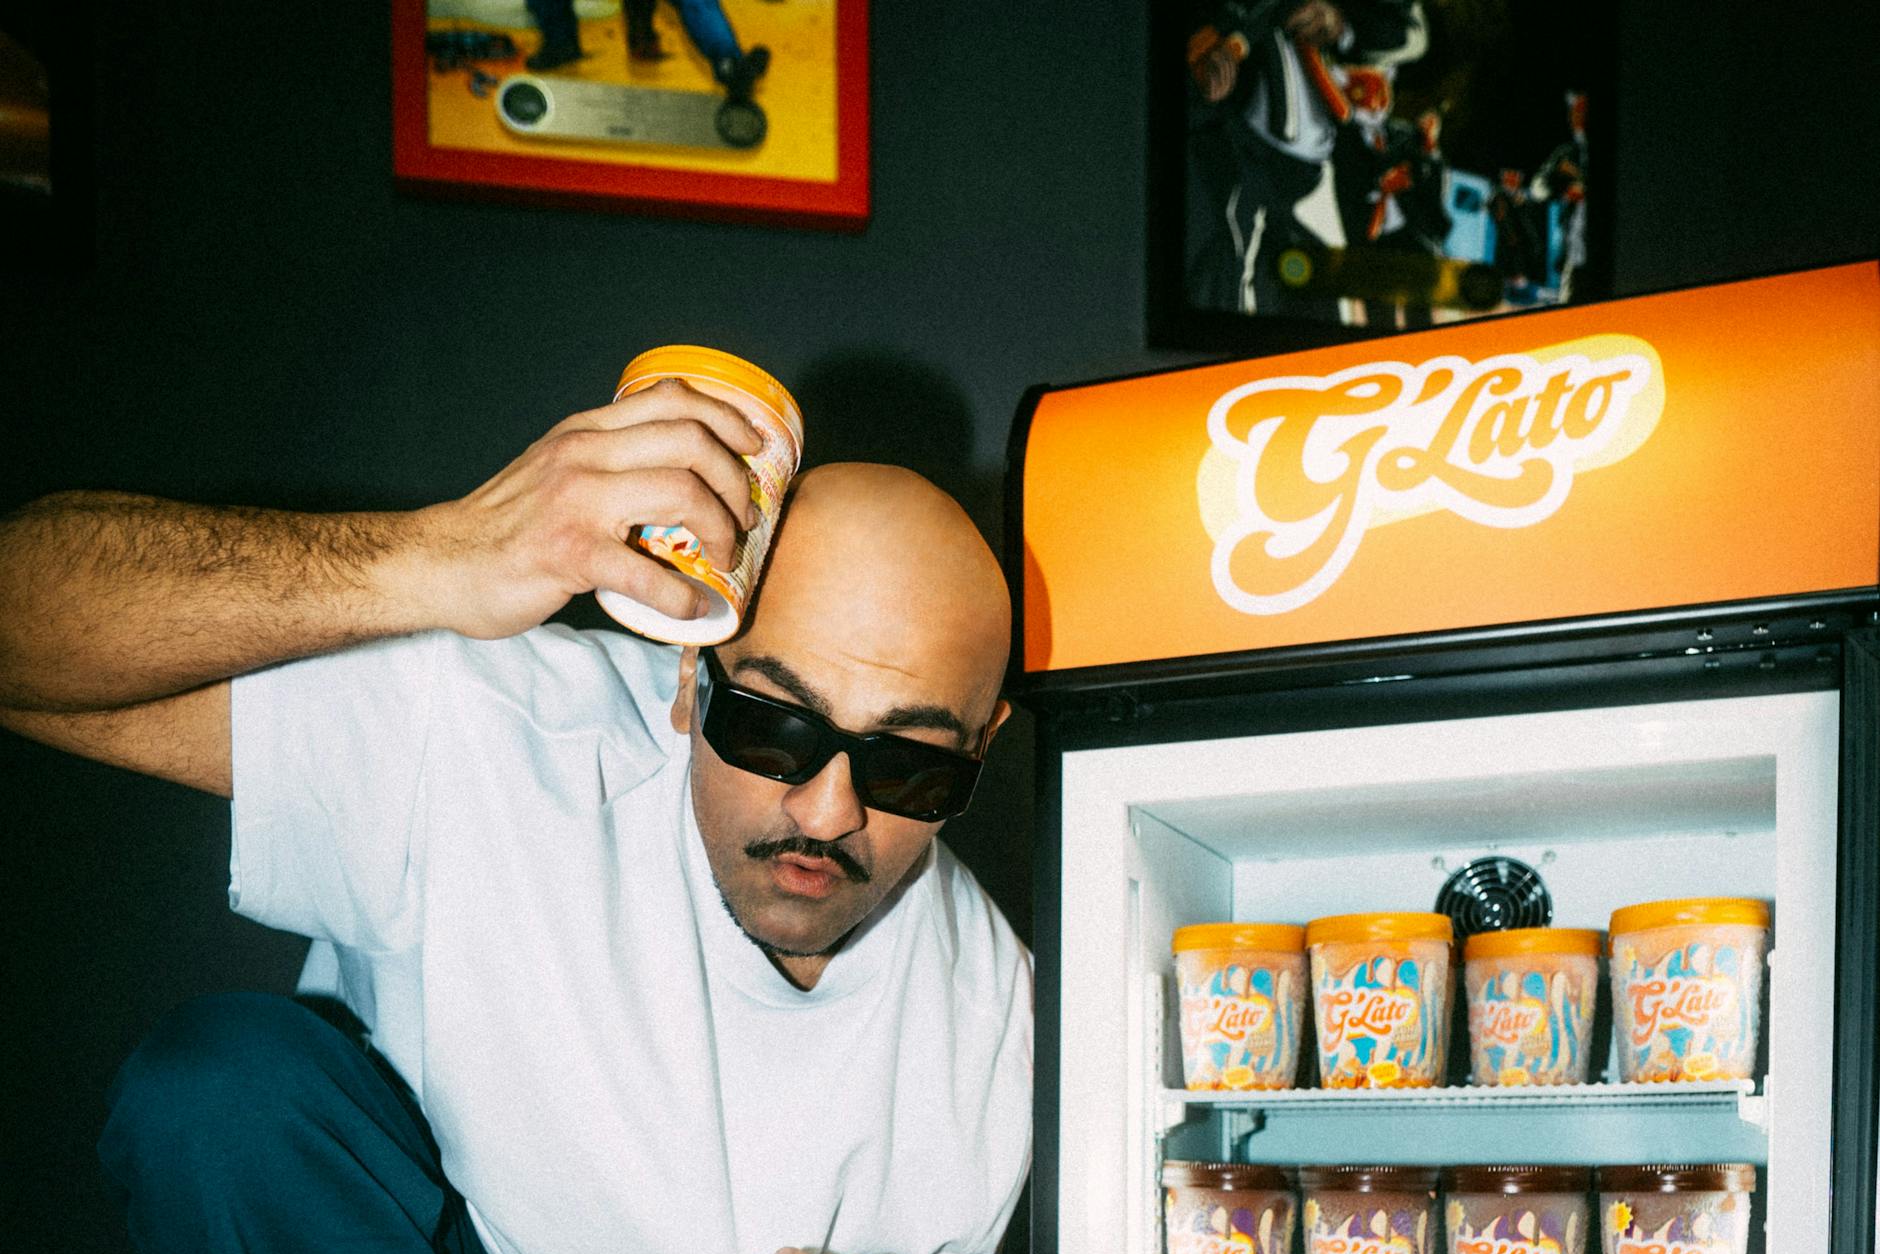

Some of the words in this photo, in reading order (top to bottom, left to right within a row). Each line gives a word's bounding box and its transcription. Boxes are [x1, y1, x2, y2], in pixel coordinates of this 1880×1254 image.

[1226, 367, 1632, 597] G'Lato
[1320, 991, 1411, 1052] G'Lato
[1627, 981, 1727, 1045] G'Lato
